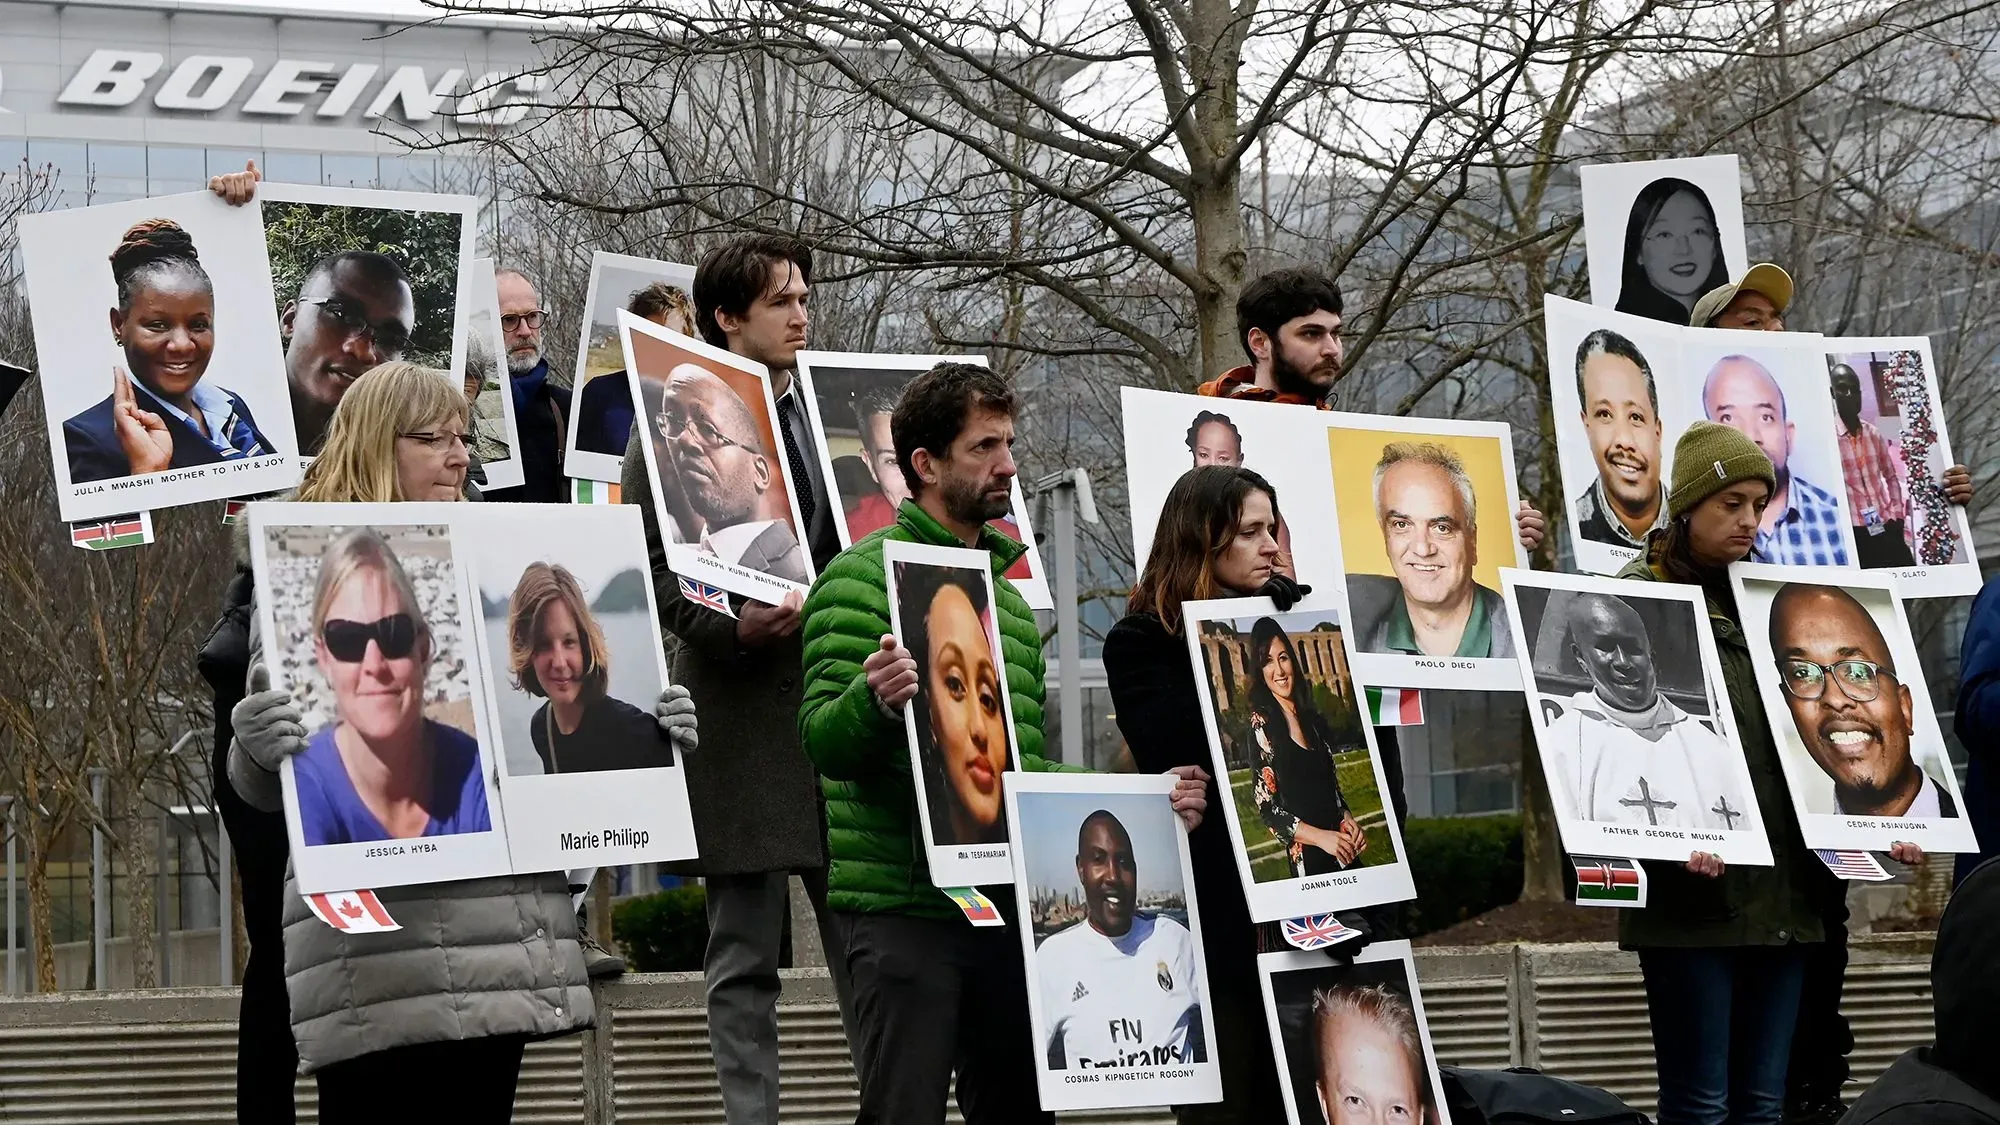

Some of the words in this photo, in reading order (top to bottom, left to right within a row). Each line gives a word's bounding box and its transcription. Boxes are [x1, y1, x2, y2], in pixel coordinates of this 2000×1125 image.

[58, 49, 547, 125] BOEING
[74, 485, 104, 496] JULIA
[111, 478, 154, 491] MWASHI
[161, 470, 205, 483] MOTHER
[212, 467, 226, 475] TO
[233, 463, 250, 472] IVY
[254, 461, 261, 469] &
[264, 457, 285, 467] JOY
[697, 556, 725, 570] JOSEPH
[728, 566, 750, 579] KURIA
[754, 574, 791, 591] WAITHAKA
[1415, 660, 1446, 668] PAOLO
[1846, 820, 1876, 829] CEDRIC
[1881, 822, 1928, 830] ASIAVUGWA
[560, 831, 599, 850] Marie
[604, 828, 649, 848] Philipp
[1602, 826, 1639, 836] FATHER
[1645, 829, 1685, 839] GEORGE
[1691, 832, 1725, 841] MUKUA
[365, 846, 405, 858] JESSICA
[411, 843, 438, 854] HYBA
[1301, 880, 1331, 891] JOANNA
[1332, 876, 1358, 886] TOOLE
[1108, 1018, 1142, 1043] Fly
[1065, 1074, 1100, 1084] COSMAS
[1105, 1071, 1154, 1082] KIPNGETICH
[1160, 1069, 1195, 1079] ROGONY
